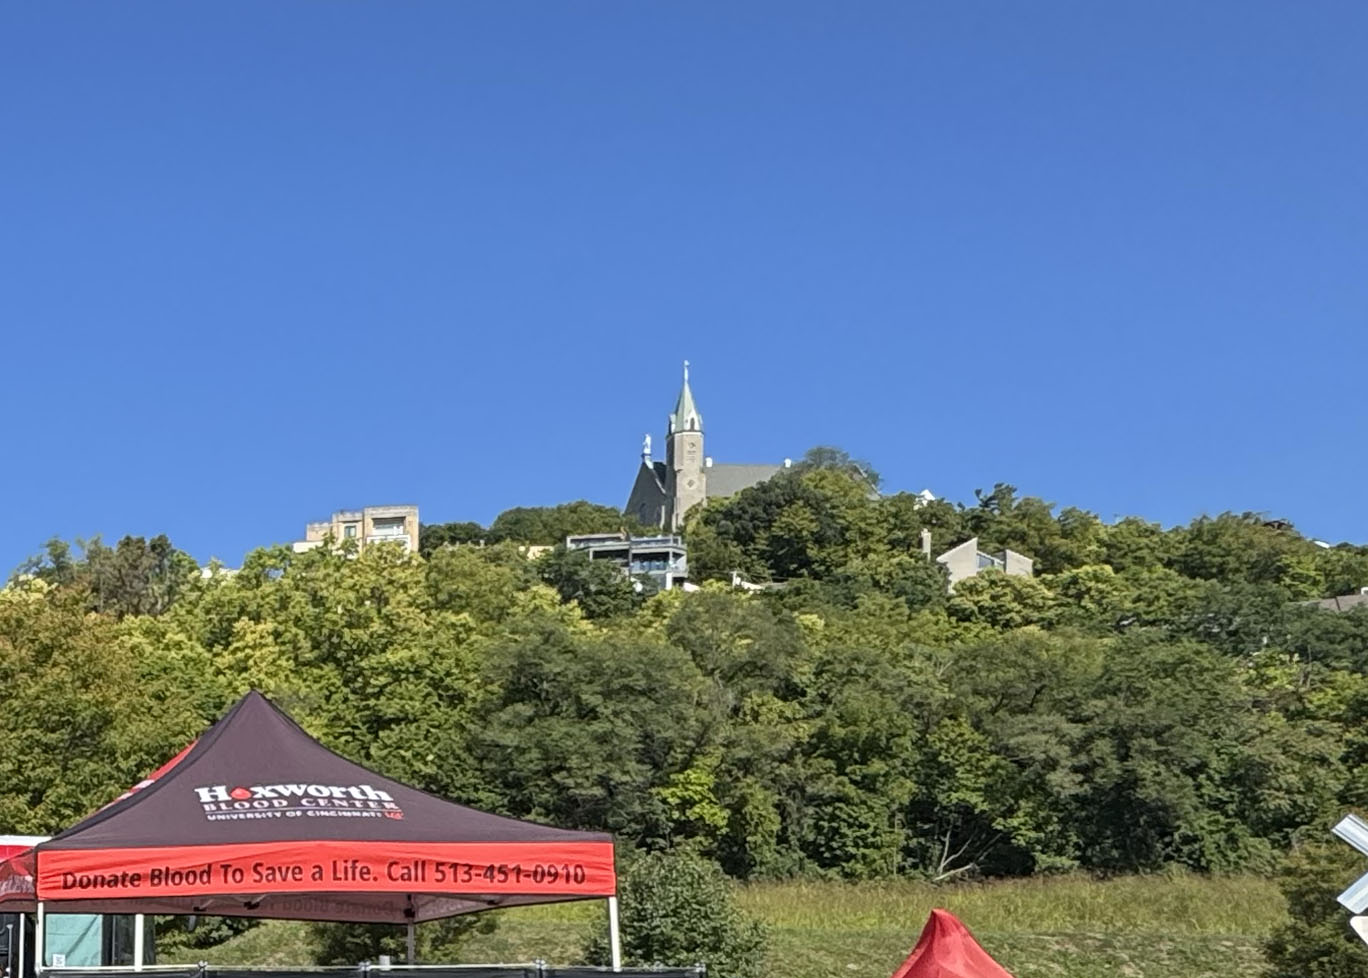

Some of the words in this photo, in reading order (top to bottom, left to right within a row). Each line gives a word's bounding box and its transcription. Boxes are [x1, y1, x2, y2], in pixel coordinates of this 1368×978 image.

[203, 799, 288, 811] BLOOD
[301, 798, 399, 809] CENTER
[207, 811, 281, 820] UNIVERSITY
[307, 810, 382, 818] CINCINNATI
[62, 871, 141, 890] Donate
[150, 864, 212, 887] Blood
[220, 864, 244, 884] To
[252, 862, 303, 883] Save
[310, 864, 323, 881] a
[332, 860, 379, 882] Life.
[386, 860, 426, 882] Call
[434, 862, 586, 885] 513-451-0910
